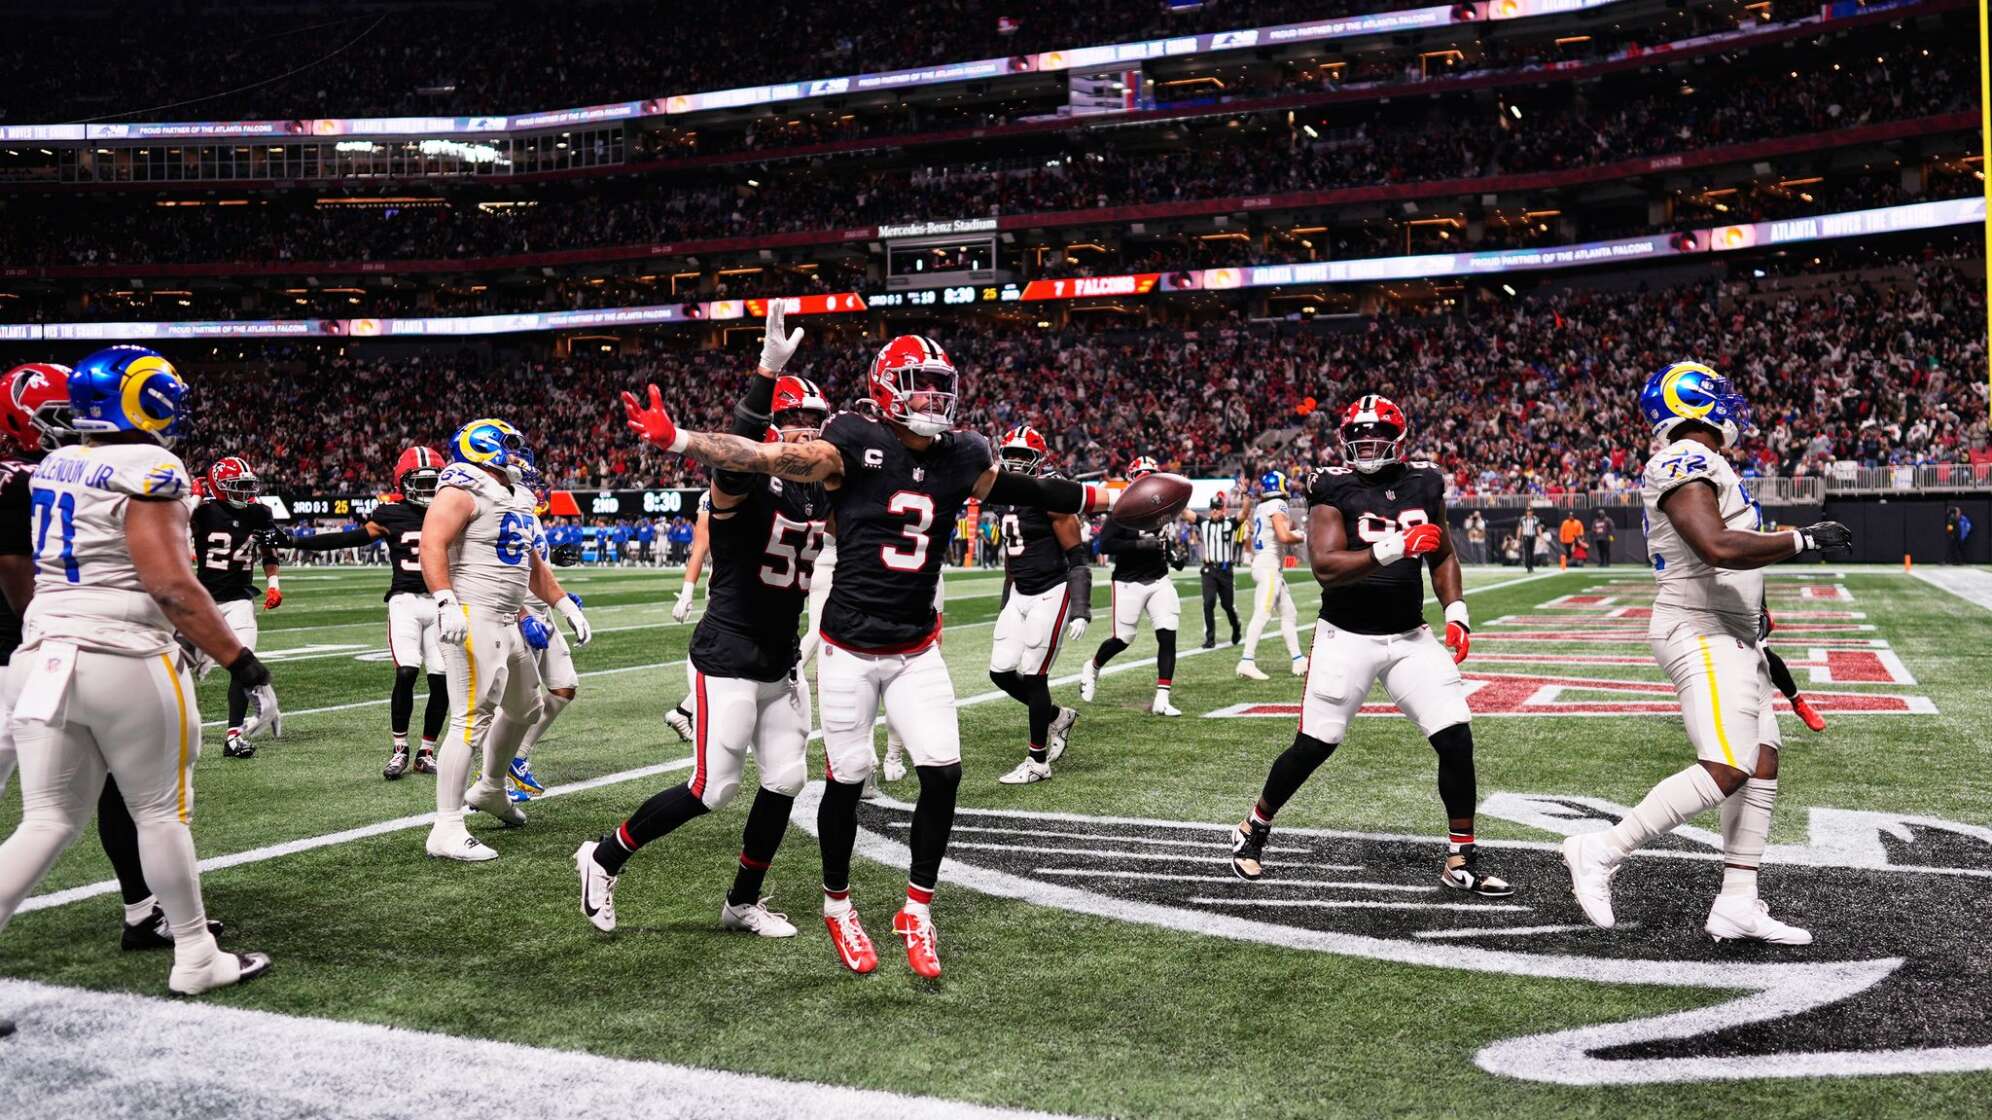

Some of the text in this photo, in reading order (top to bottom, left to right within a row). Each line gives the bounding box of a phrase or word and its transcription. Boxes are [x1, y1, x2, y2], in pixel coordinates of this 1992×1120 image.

[1270, 13, 1436, 39] PROUD PARTNER OF THE ATLANTA FALCONS
[191, 126, 200, 134] OF
[879, 222, 952, 237] Mercedes-Benz
[954, 219, 997, 232] Stadium
[1771, 221, 1816, 241] ATLANTA
[1470, 242, 1652, 266] PROUD PARTNER OF THE ATLANTA FALCONS
[944, 286, 975, 304] 8:30
[983, 288, 998, 300] 25
[1054, 276, 1135, 296] 7 FALCONS
[193, 326, 222, 334] PARTNER
[277, 324, 308, 332] FALCONS
[866, 449, 883, 465] C
[1661, 455, 1707, 478] 72
[86, 464, 116, 490] JR
[145, 469, 182, 494] 71
[770, 476, 783, 492] C
[293, 501, 312, 514] 3RD
[322, 501, 328, 513] 3
[334, 500, 349, 514] 25
[592, 492, 682, 513] 2ND 8:30
[31, 487, 81, 584] 71
[496, 512, 535, 566] 67
[880, 490, 935, 571] 3
[206, 532, 254, 571] 24
